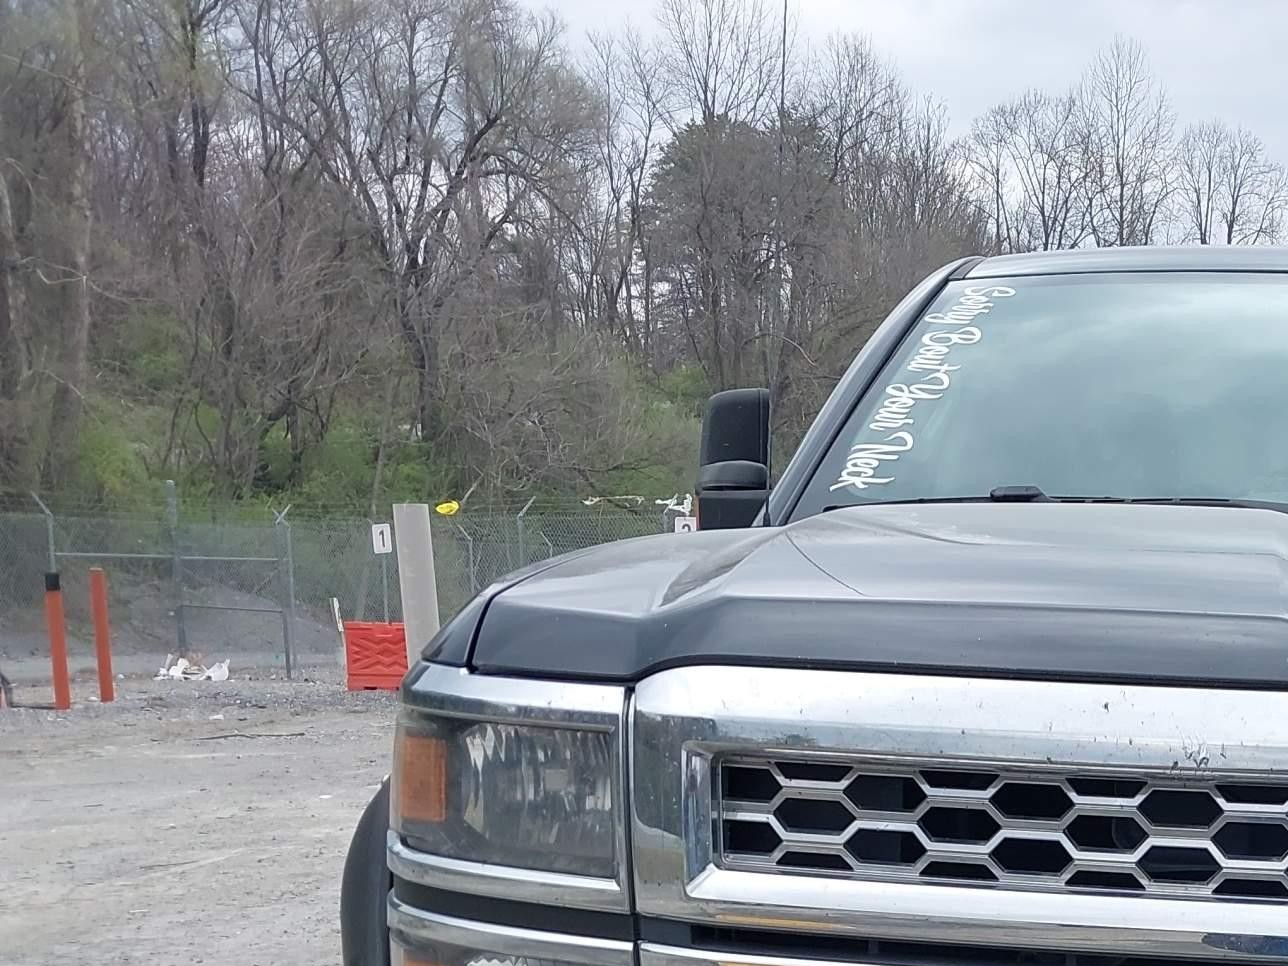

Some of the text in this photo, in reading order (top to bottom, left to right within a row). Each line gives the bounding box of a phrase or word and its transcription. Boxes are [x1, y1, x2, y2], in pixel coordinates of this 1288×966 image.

[829, 286, 1016, 492] Sorry Bout Your Neck
[378, 528, 386, 548] 1
